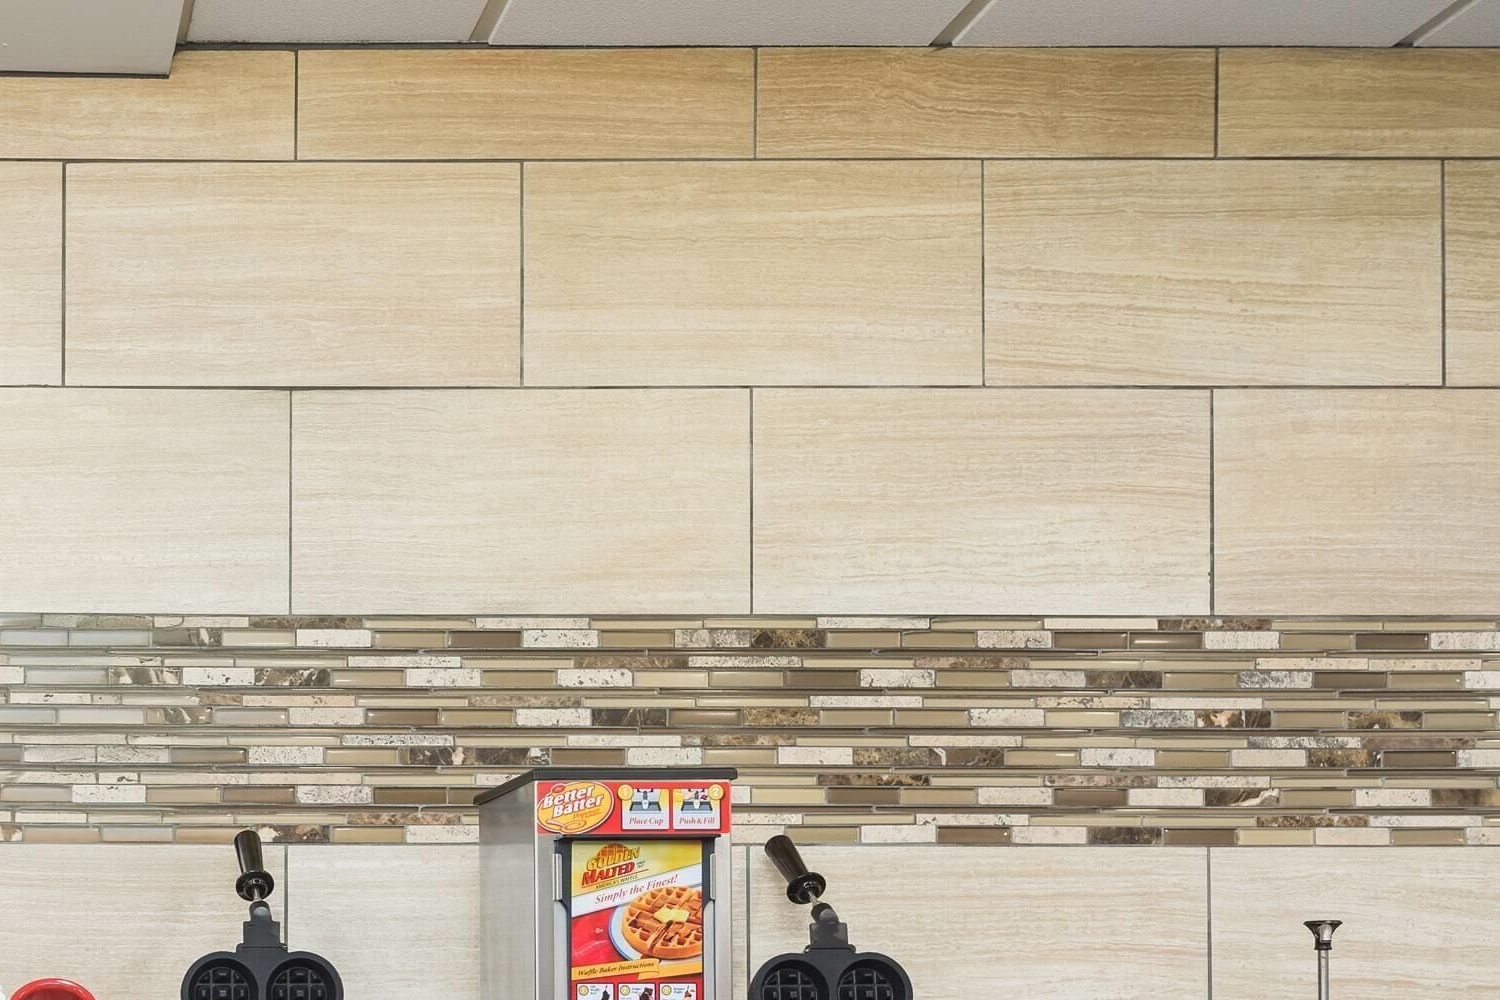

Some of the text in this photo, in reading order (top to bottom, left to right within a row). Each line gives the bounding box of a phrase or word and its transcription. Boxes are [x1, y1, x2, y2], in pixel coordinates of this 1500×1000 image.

[541, 785, 595, 810] Better
[552, 794, 604, 818] Batter
[629, 817, 664, 826] Place Cup
[679, 817, 696, 825] Push
[703, 817, 715, 825] Fill
[586, 847, 641, 871] GOLDEN
[581, 861, 635, 886] MALTED
[595, 874, 678, 904] Simply the Finest!
[578, 962, 655, 976] Waffle Baker Instructions
